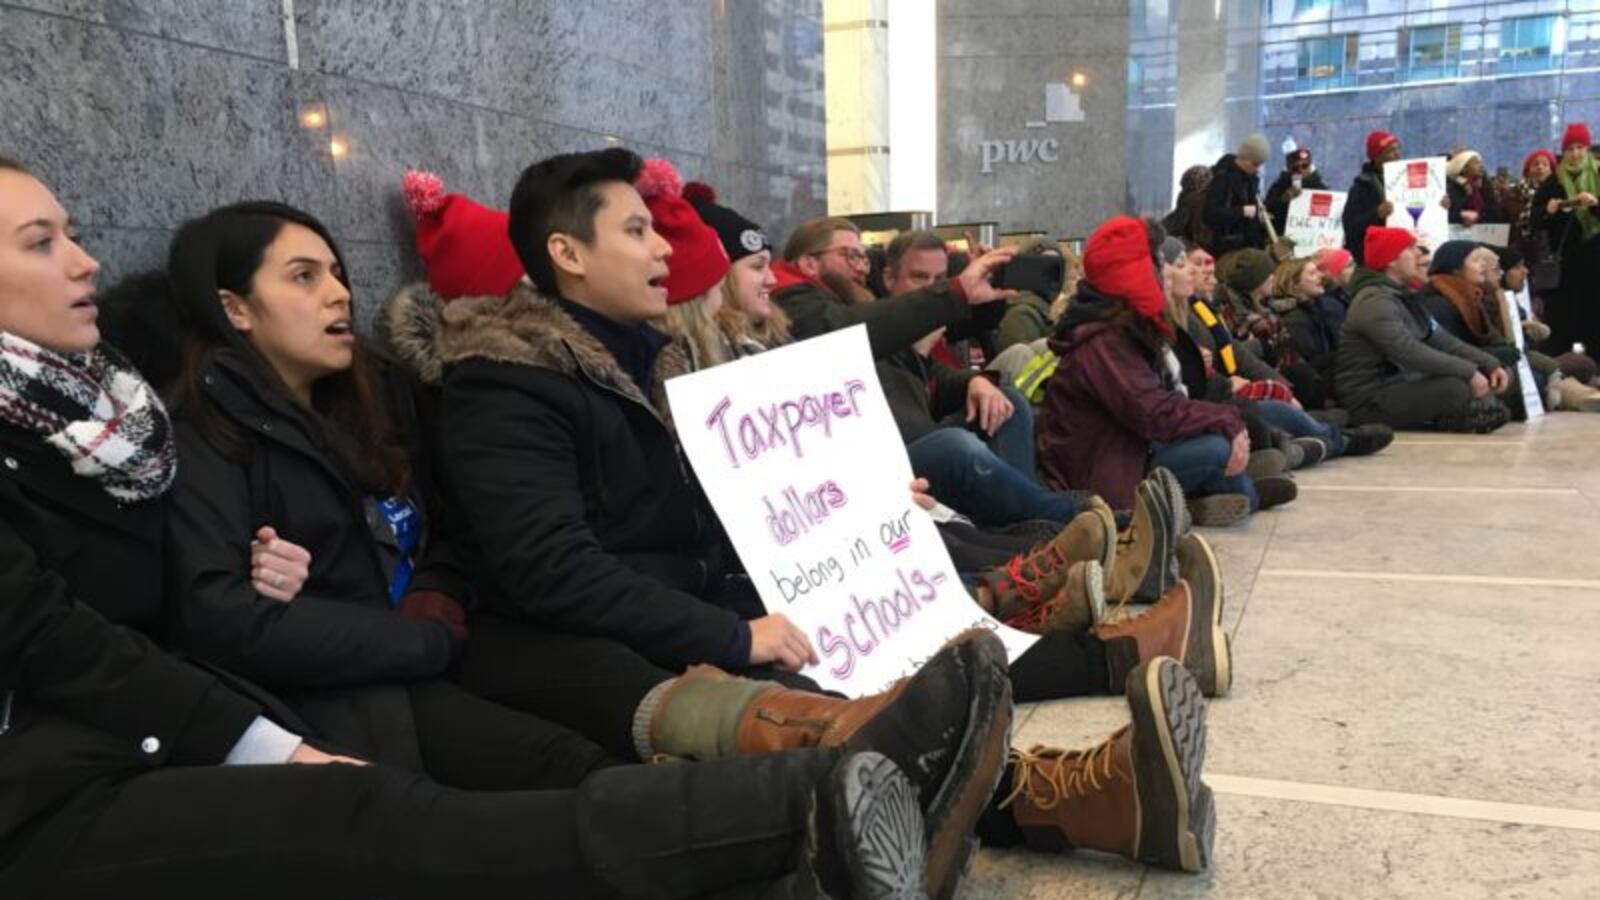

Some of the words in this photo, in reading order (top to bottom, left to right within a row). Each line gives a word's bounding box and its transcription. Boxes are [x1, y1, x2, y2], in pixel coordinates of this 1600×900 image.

[981, 137, 1058, 173] pwc
[705, 379, 866, 469] Taxpayer
[763, 479, 848, 547] dollars
[770, 558, 844, 606] belong
[850, 536, 872, 566] in
[879, 509, 912, 545] our
